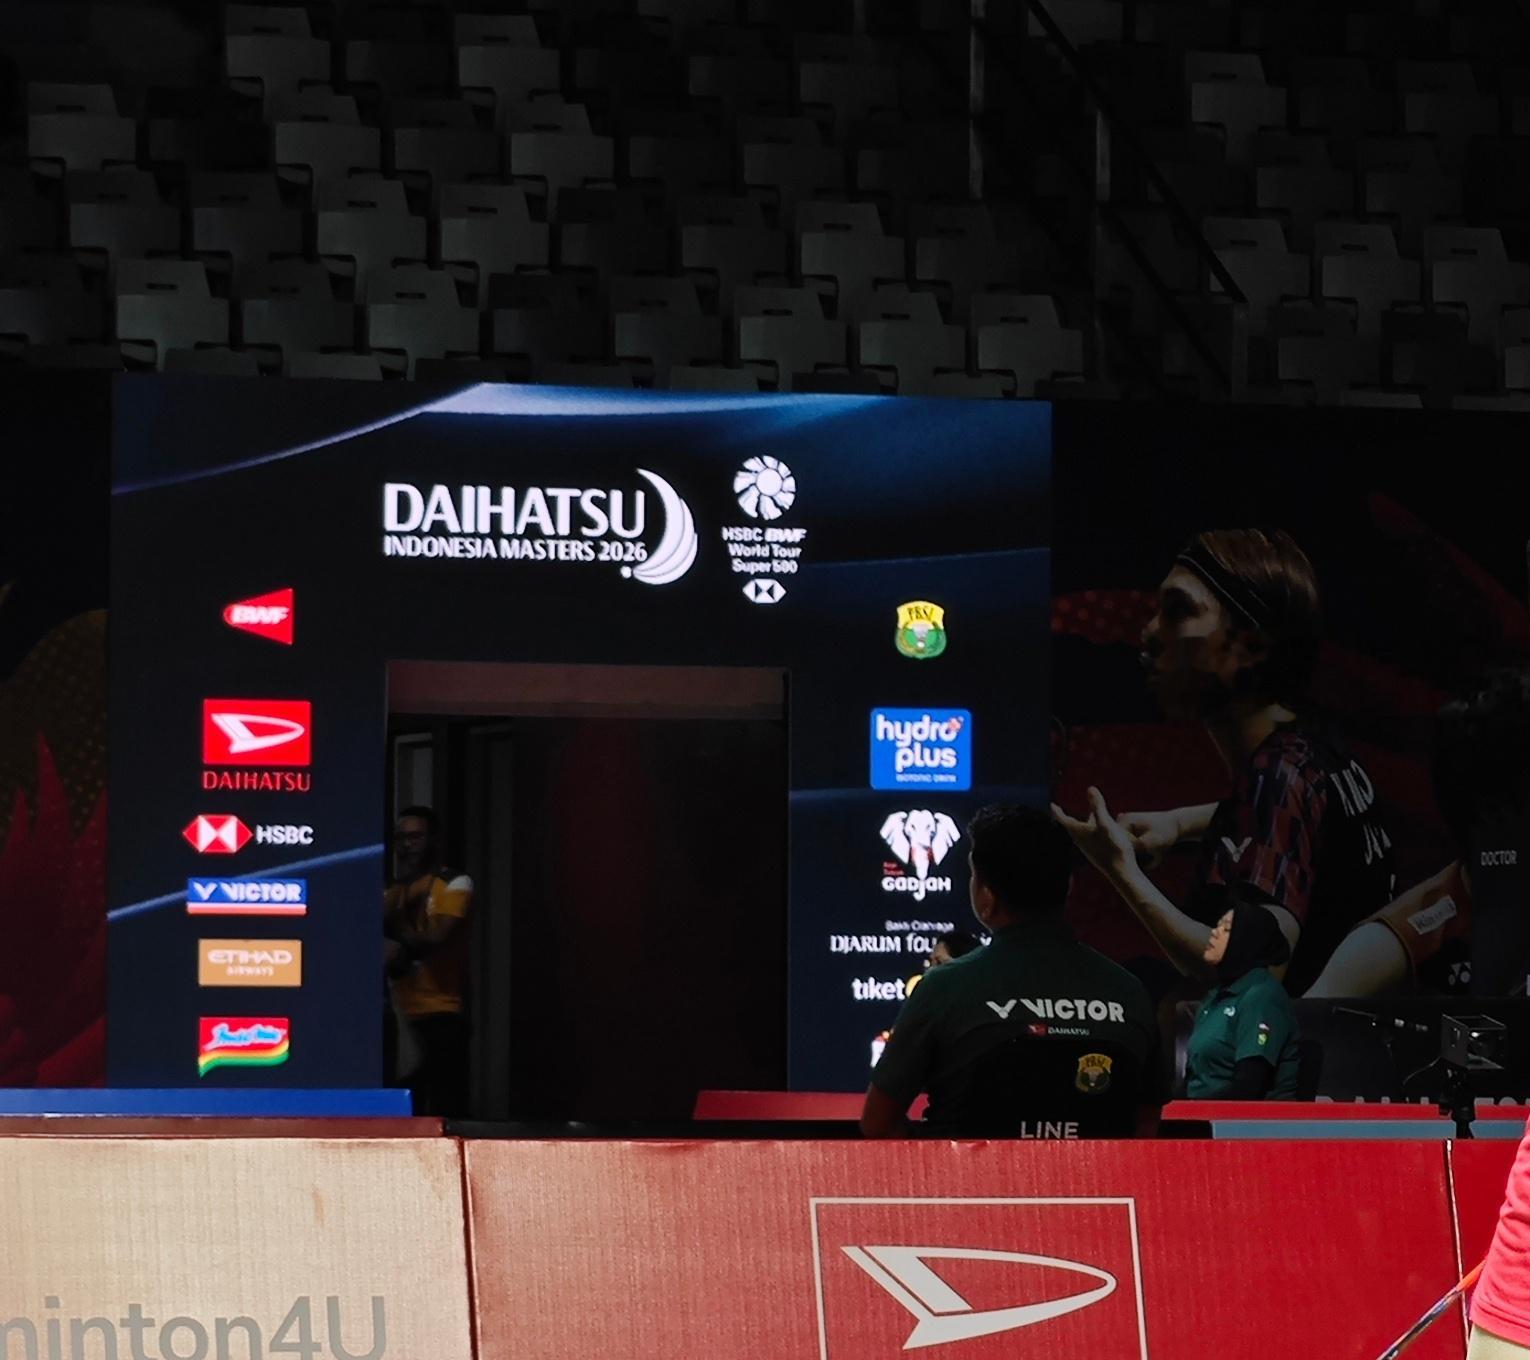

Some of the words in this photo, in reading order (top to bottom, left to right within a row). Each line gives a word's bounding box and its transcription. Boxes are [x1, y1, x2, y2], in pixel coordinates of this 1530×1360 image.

[383, 482, 645, 538] DAIHATSU
[722, 526, 763, 541] HSBC
[384, 535, 497, 560] INDONESIA
[500, 538, 595, 562] MASTERS
[599, 540, 648, 563] 2026
[728, 543, 769, 558] World
[771, 543, 802, 558] Tour
[732, 558, 771, 574] Super
[772, 559, 798, 573] 500
[231, 605, 289, 625] BWF
[876, 713, 957, 748] hydro
[895, 742, 957, 772] plus
[203, 771, 311, 791] DAIHATSU
[256, 824, 314, 844] HSBC
[1480, 850, 1517, 866] DOCTOR
[219, 882, 302, 902] VICTOR
[830, 934, 901, 954] DJARUM
[208, 949, 293, 964] ETIHAD
[852, 977, 905, 1000] tiket
[1020, 998, 1126, 1023] VICTOR
[1020, 1121, 1080, 1139] LINE
